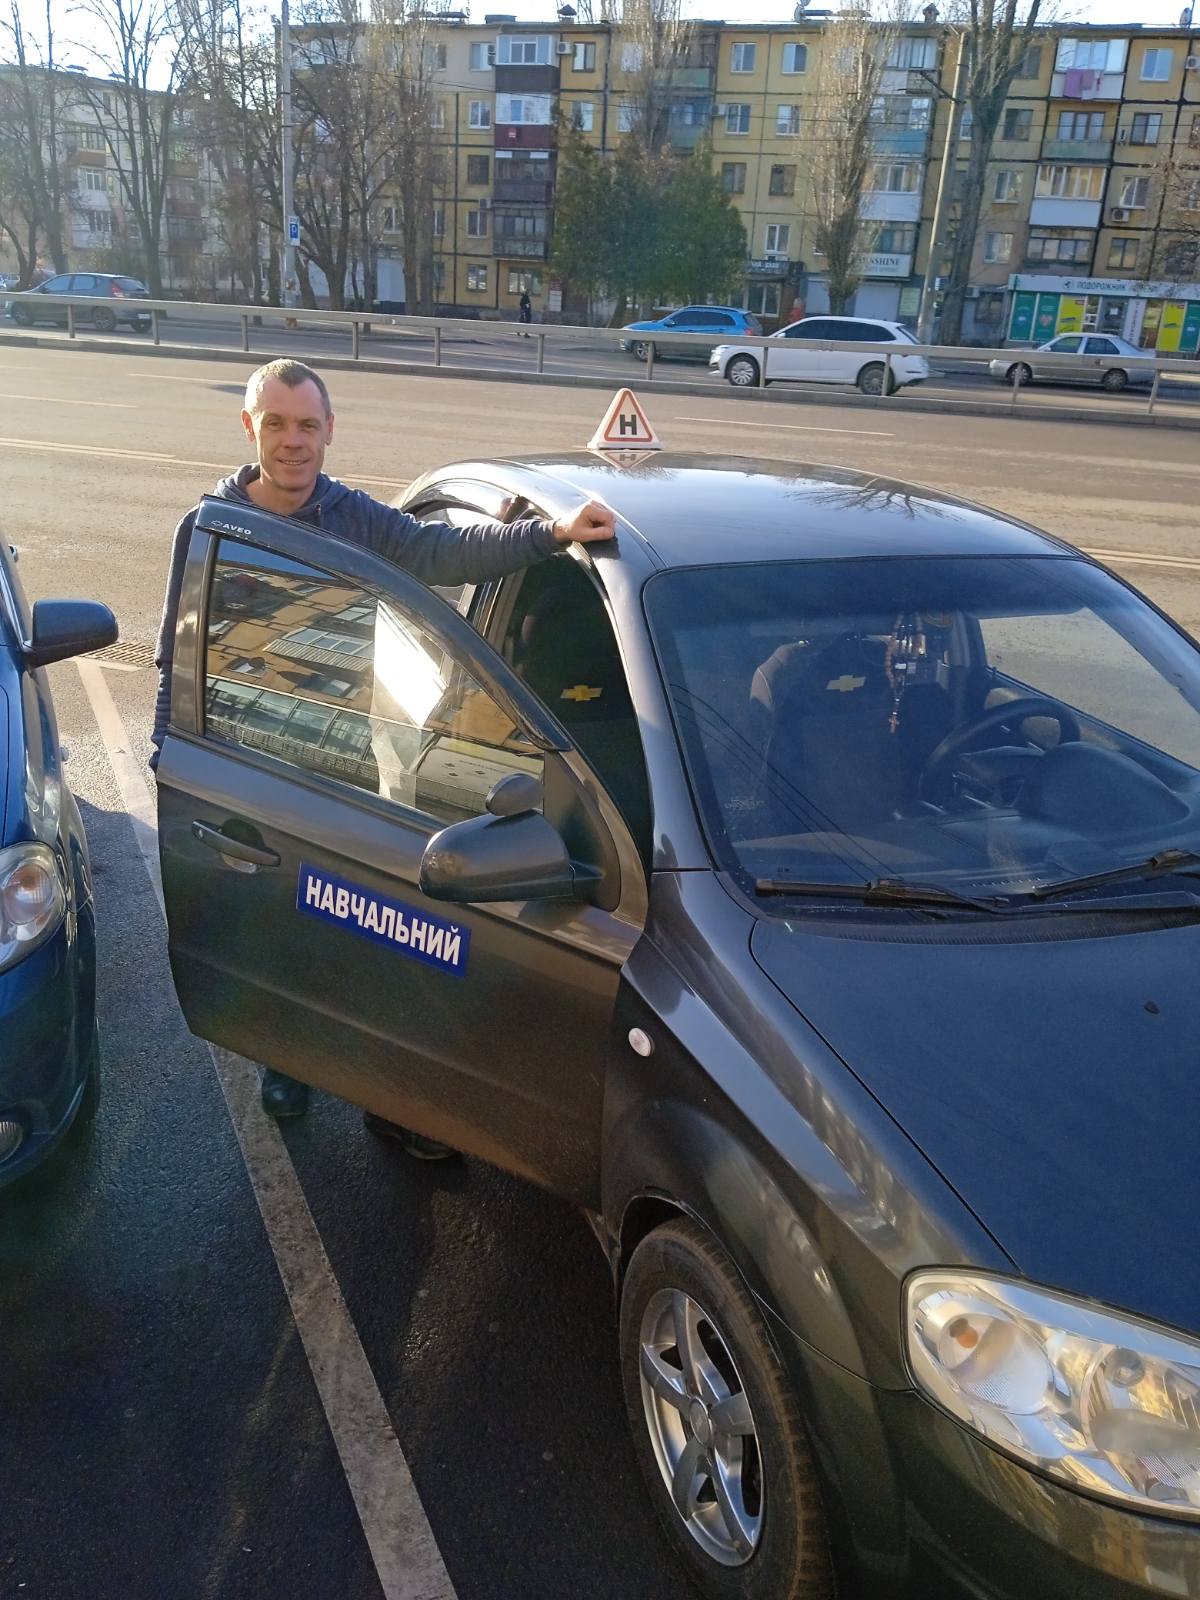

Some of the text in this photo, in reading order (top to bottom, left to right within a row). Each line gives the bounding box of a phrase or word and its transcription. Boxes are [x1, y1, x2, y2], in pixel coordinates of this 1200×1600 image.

[620, 414, 637, 435] Н
[223, 524, 252, 535] AVEO
[305, 875, 461, 966] НАВЧАЛЬНИЙ
